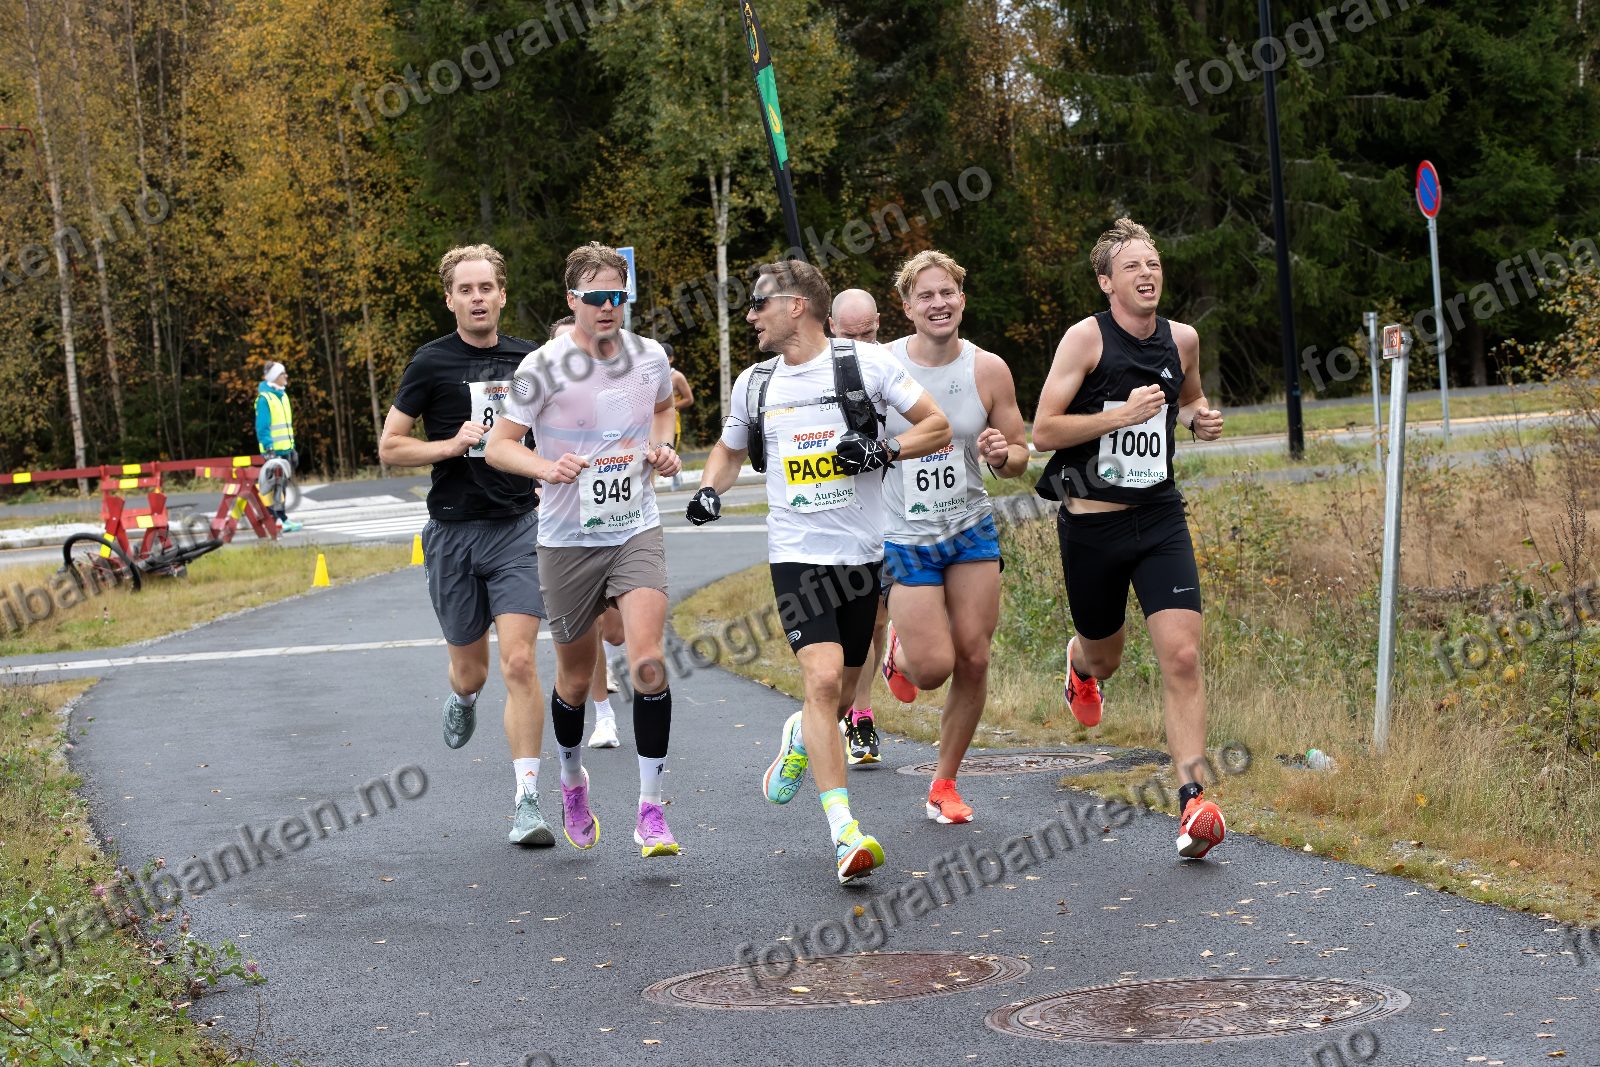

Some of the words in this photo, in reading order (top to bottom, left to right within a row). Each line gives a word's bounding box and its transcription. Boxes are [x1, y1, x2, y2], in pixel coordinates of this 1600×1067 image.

[792, 430, 835, 442] NORGES
[797, 439, 829, 450] LØPET
[1108, 430, 1161, 458] 1000
[594, 454, 634, 466] NORGES
[920, 453, 950, 463] LØPET
[597, 463, 629, 473] LØPET
[916, 465, 956, 492] 616
[1126, 468, 1165, 481] Aurskog
[592, 476, 631, 505] 949
[814, 487, 854, 502] Aurskog
[932, 497, 965, 509] Aurskog
